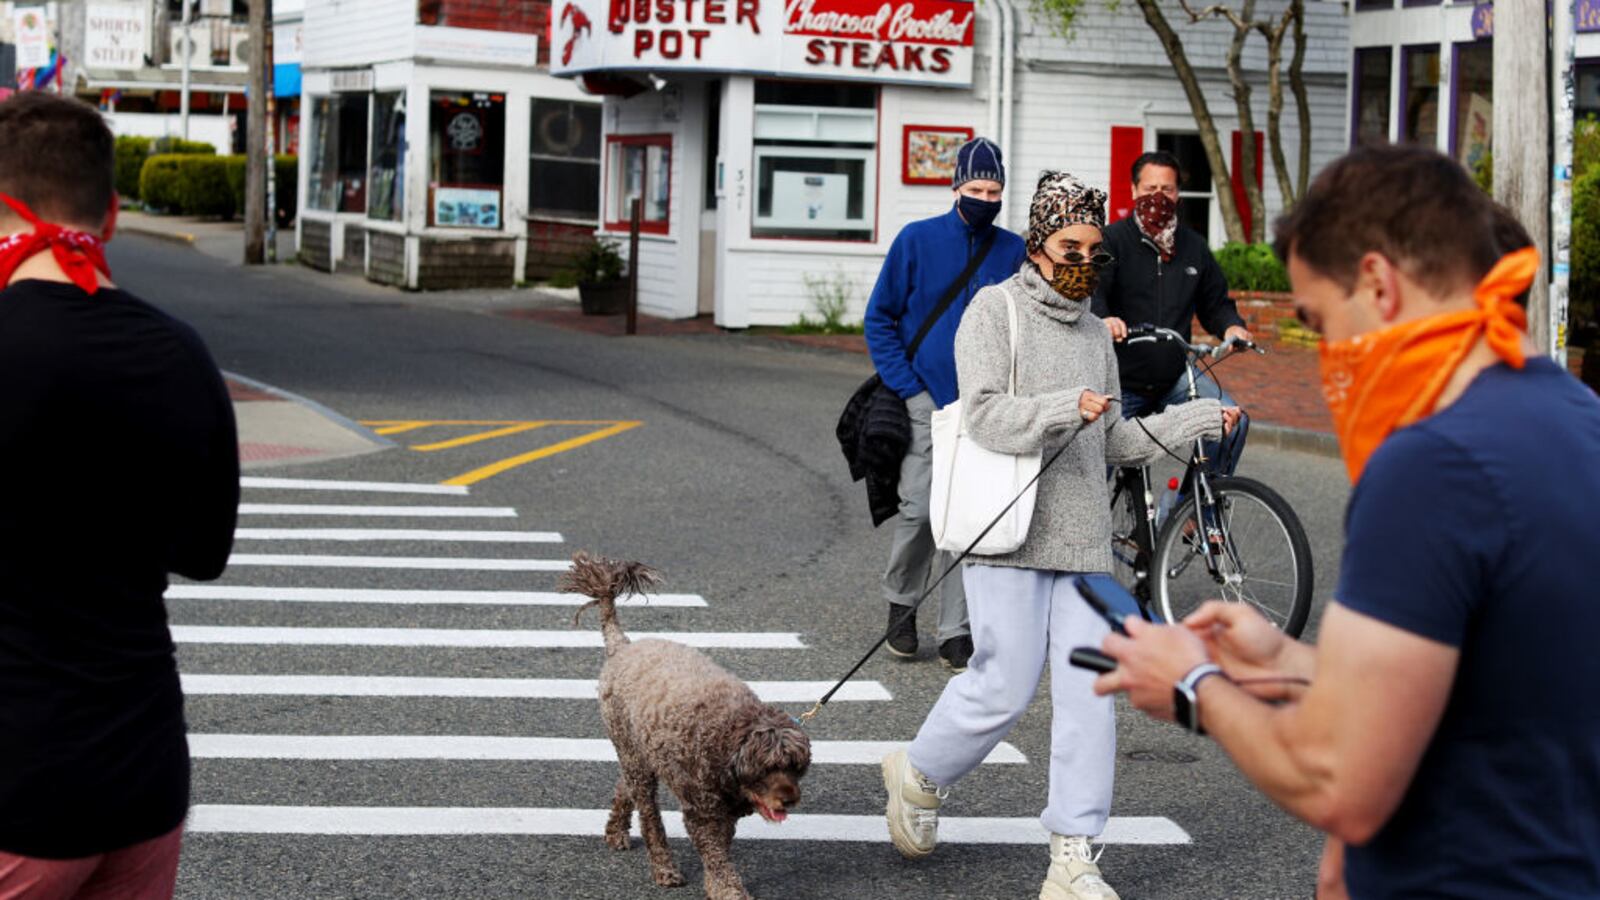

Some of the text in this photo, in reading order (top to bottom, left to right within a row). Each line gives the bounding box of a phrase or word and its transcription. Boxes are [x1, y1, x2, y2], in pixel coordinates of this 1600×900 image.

[90, 18, 142, 32] SHIRTS
[608, 0, 760, 34] LOBSTER
[784, 0, 973, 41] Charcoal Broiled
[91, 48, 138, 63] STUFF
[634, 29, 711, 59] POT
[804, 38, 953, 73] STEAKS
